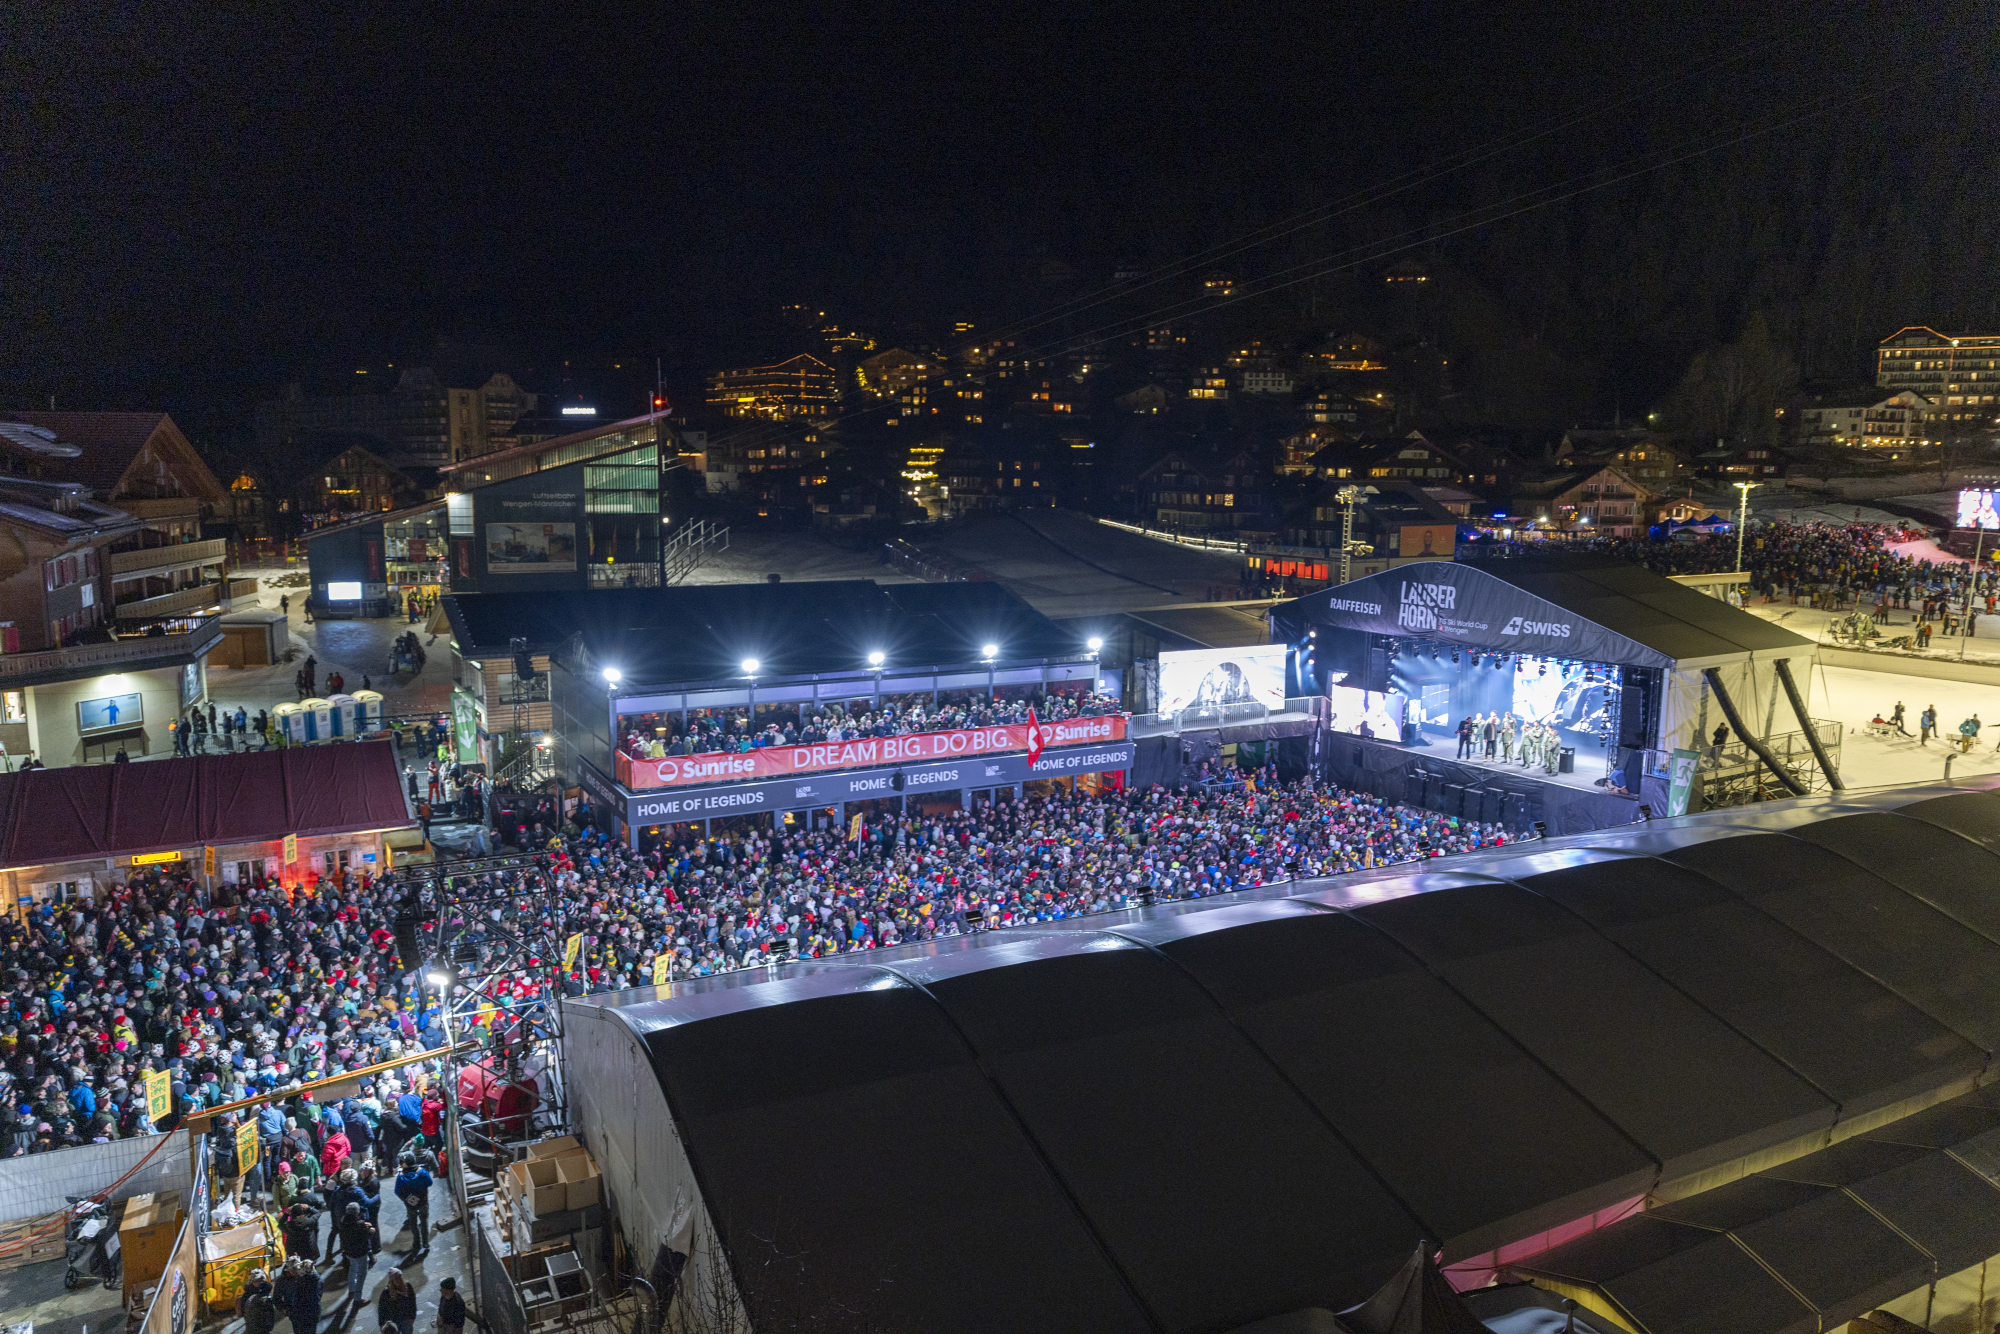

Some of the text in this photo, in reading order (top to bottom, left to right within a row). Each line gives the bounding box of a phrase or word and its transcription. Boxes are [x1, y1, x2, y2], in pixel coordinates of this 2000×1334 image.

[1401, 581, 1456, 609] LAUBER
[1330, 598, 1381, 615] RAIFFEISEN
[1398, 604, 1438, 629] HORN
[1456, 620, 1474, 628] World
[1474, 621, 1488, 630] Cup
[1444, 626, 1468, 635] Wengen
[1523, 621, 1571, 637] SWISS
[1055, 722, 1110, 741] Sunrise
[794, 729, 1013, 768] DREAM BIG. DO BIG.
[683, 756, 755, 778] Sunrise
[1033, 752, 1128, 771] HOME OF LEGENDS
[850, 778, 886, 792] HOME
[907, 770, 958, 785] LEGENDS
[638, 801, 679, 816] HOME
[683, 798, 701, 811] OF
[705, 792, 764, 809] LEGENDS
